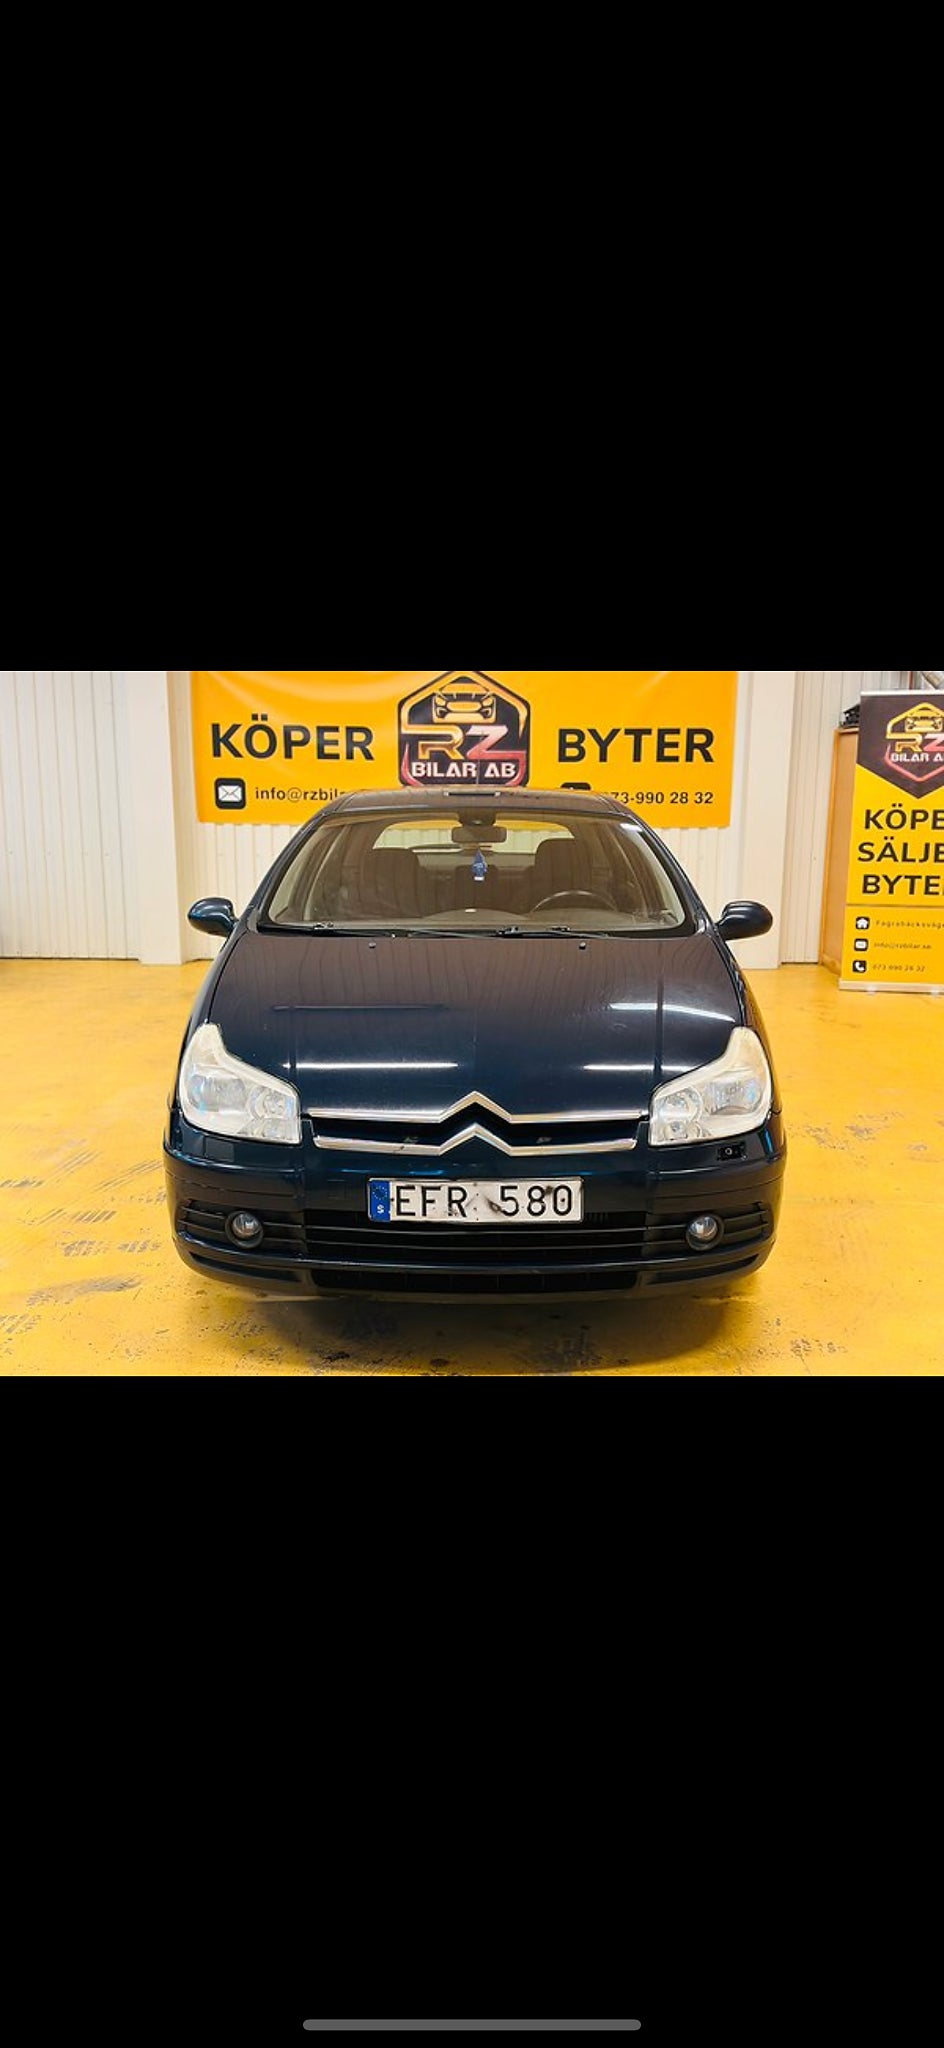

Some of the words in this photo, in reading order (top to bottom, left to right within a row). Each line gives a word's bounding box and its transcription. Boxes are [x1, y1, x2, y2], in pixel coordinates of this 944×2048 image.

[211, 713, 375, 761] KÖPER
[401, 724, 527, 760] RZ
[558, 728, 714, 763] BYTER
[411, 762, 478, 778] BILAR
[484, 762, 516, 778] AB
[604, 791, 665, 804] 73-990
[670, 792, 689, 804] 28
[694, 792, 714, 804] 32
[376, 1204, 386, 1214] S
[396, 1185, 468, 1217] EFR
[500, 1185, 573, 1217] 580
